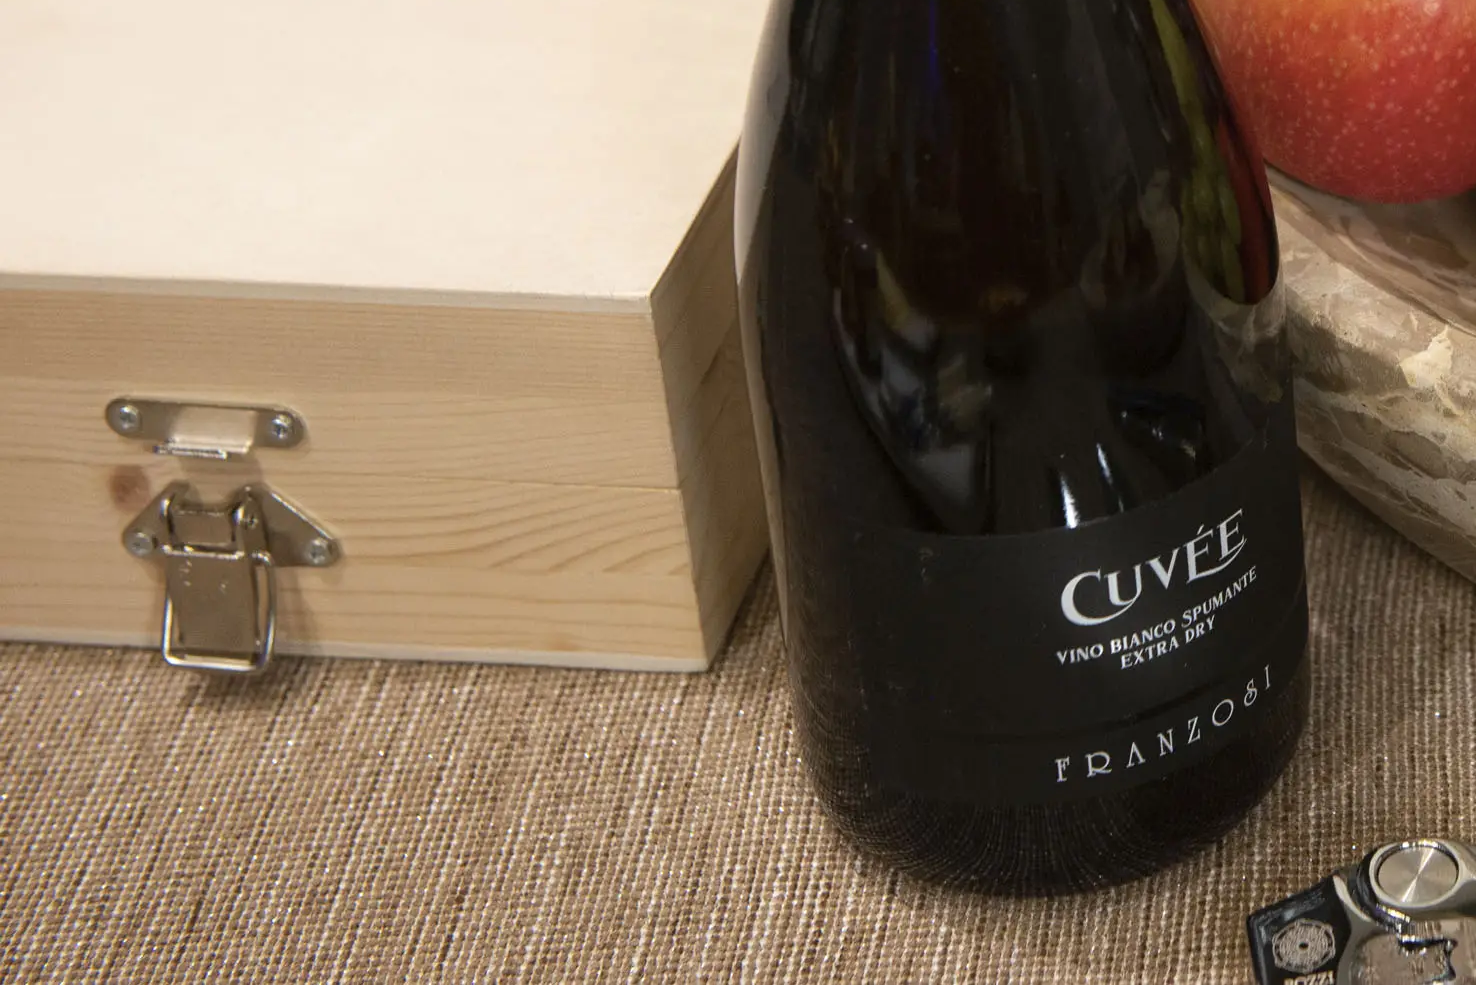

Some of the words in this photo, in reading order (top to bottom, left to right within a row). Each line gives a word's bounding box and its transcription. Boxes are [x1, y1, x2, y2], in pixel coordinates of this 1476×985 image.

[1056, 644, 1104, 665] VINO
[1110, 619, 1176, 655] BIANCO
[1181, 565, 1257, 627] SPUMANTE
[1060, 508, 1248, 626] CUVÉE
[1120, 637, 1179, 670] EXTRA
[1184, 614, 1216, 645] DRY
[1054, 665, 1271, 783] FRANZOSI
